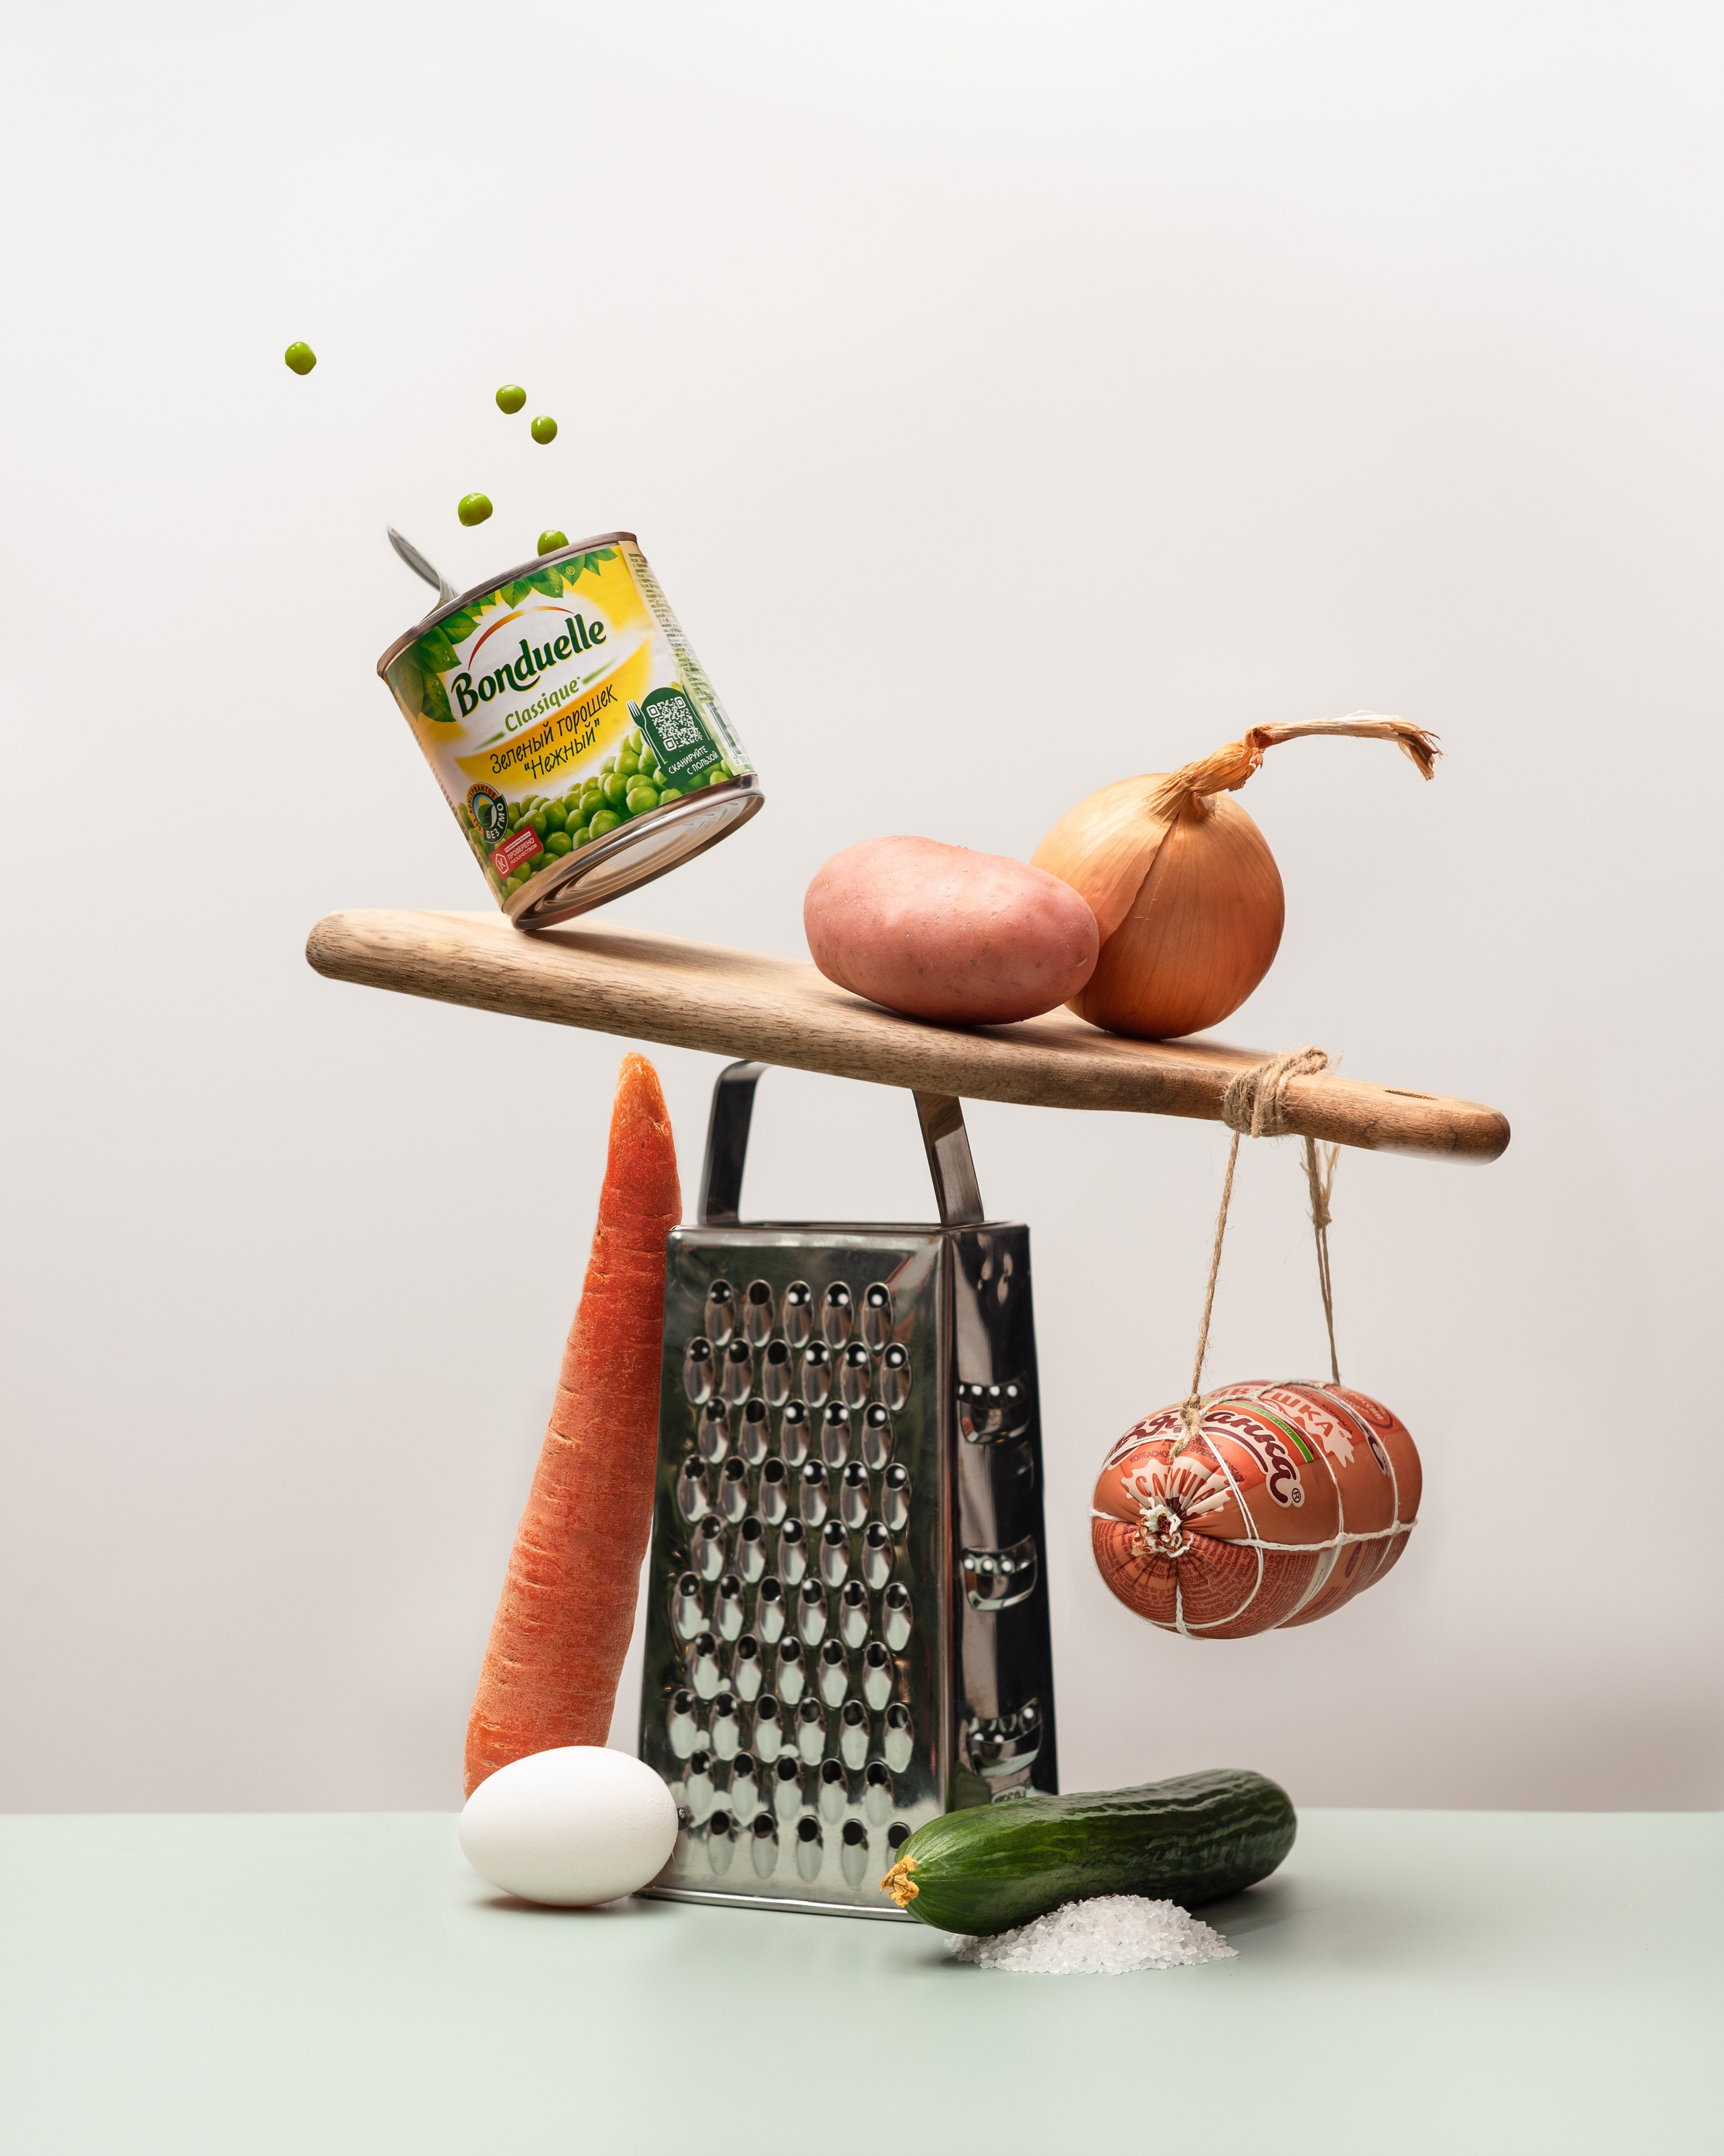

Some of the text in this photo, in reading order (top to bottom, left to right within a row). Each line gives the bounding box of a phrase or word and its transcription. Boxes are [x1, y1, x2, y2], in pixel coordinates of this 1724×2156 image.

[451, 614, 606, 718] Bonduelle
[490, 721, 554, 774] Зеленый
[557, 684, 618, 737] горошек
[668, 745, 708, 774] СКАНИРУЙТЕ
[692, 750, 719, 771] ПОЛЬЗОЙ
[469, 785, 497, 814] КОНСЕРВАНТОВ
[486, 803, 505, 839] БЕЗ ГМО
[507, 837, 535, 860] ПРОВЕРЕНО
[510, 843, 538, 865] РОСКАЧЕСТВОМ
[1267, 1554, 1275, 1564] 48
[1269, 1555, 1282, 1577] СРОК
